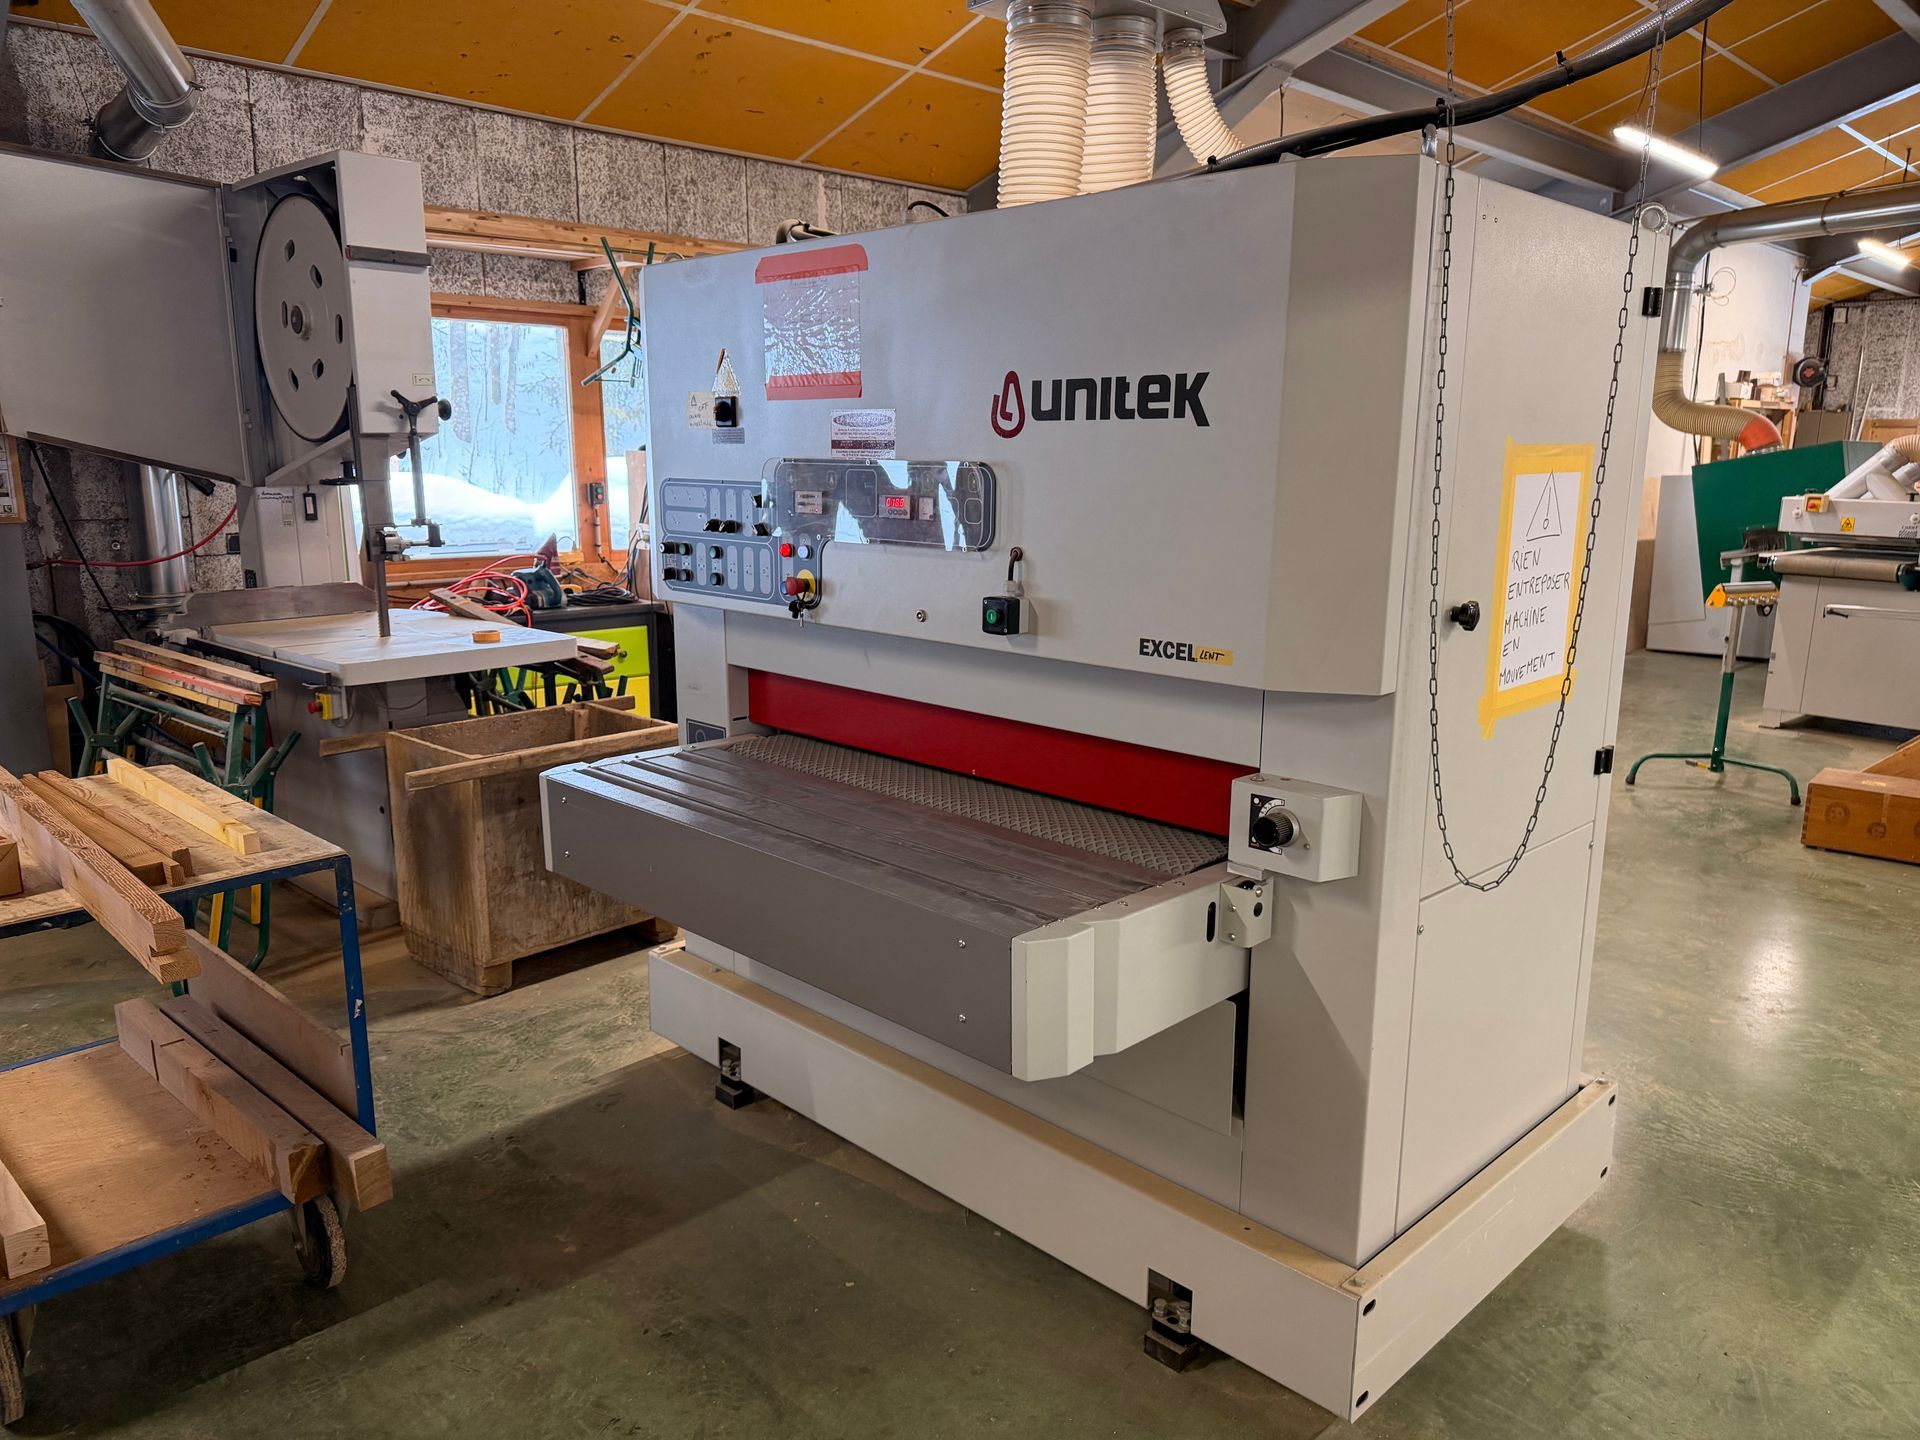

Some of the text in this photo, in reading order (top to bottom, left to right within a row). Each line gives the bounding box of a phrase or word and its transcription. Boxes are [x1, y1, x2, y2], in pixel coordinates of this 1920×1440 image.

[1511, 547, 1541, 572] RIEN
[1507, 571, 1571, 601] ENTREPOSER
[1503, 605, 1549, 635] MACHINE
[1139, 637, 1198, 662] EXCEL
[1199, 649, 1225, 662] LENT
[1502, 637, 1521, 658] EN
[1498, 652, 1556, 687] MOUVEMENT
